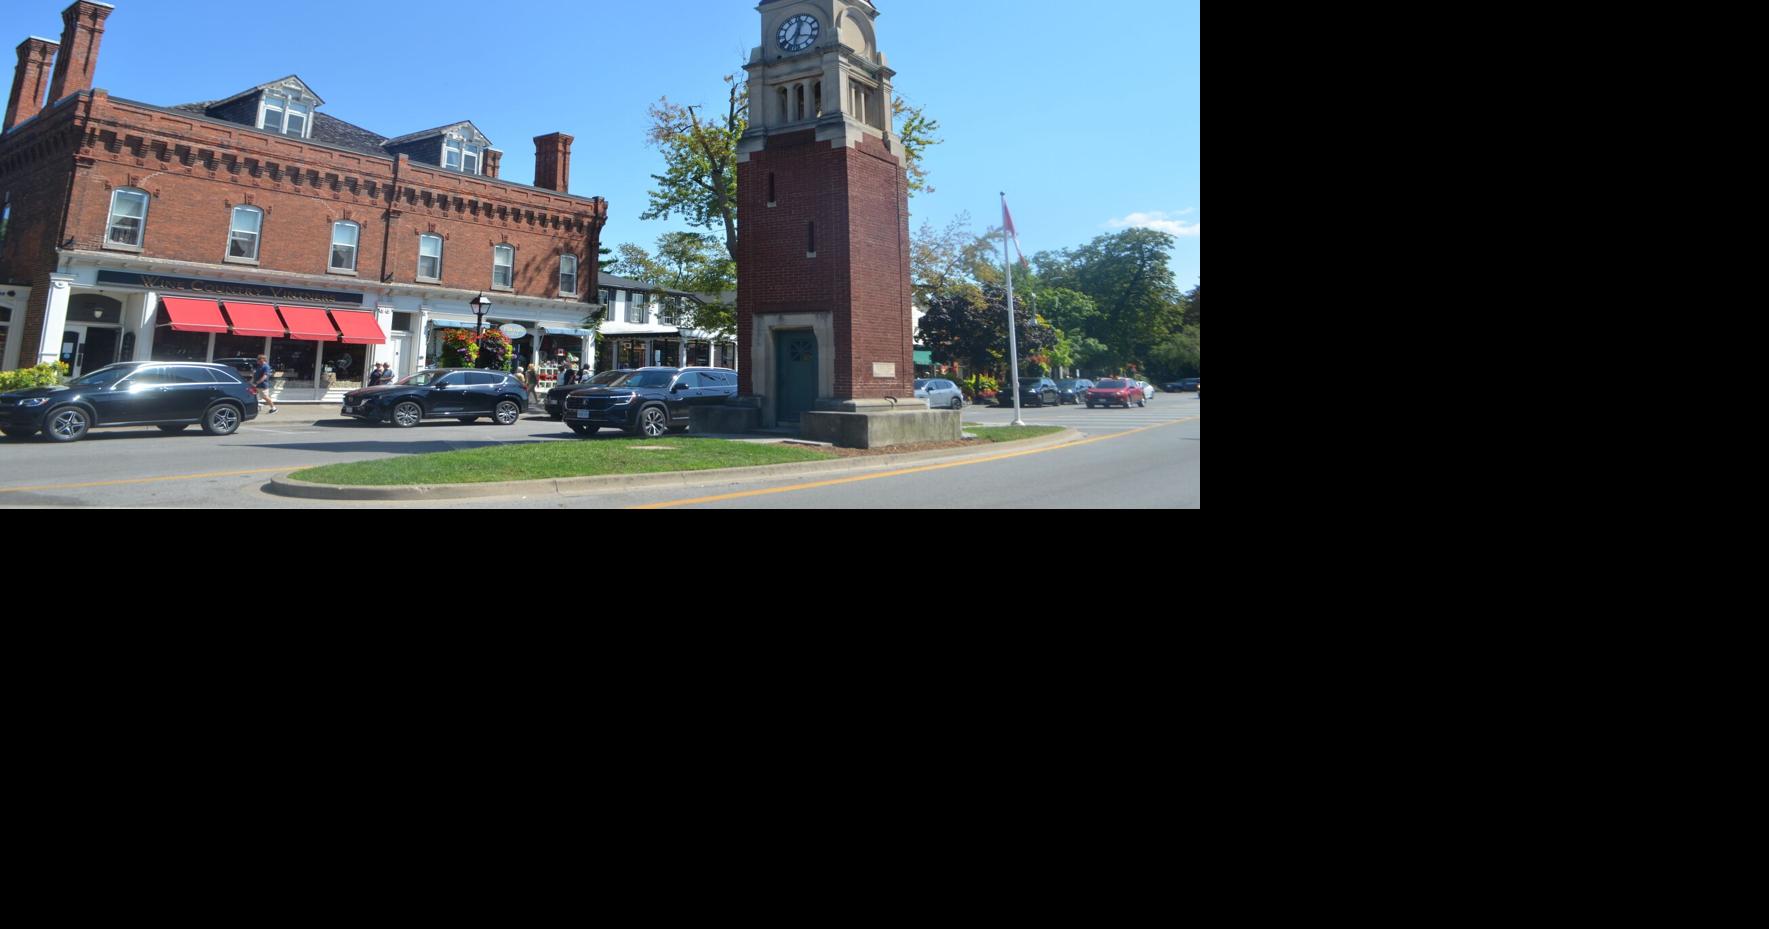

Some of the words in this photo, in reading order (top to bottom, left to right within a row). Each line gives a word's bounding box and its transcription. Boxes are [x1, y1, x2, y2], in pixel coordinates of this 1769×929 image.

[141, 275, 185, 290] WINE
[191, 280, 263, 297] COUNTRY
[270, 287, 336, 303] VINTNERS
